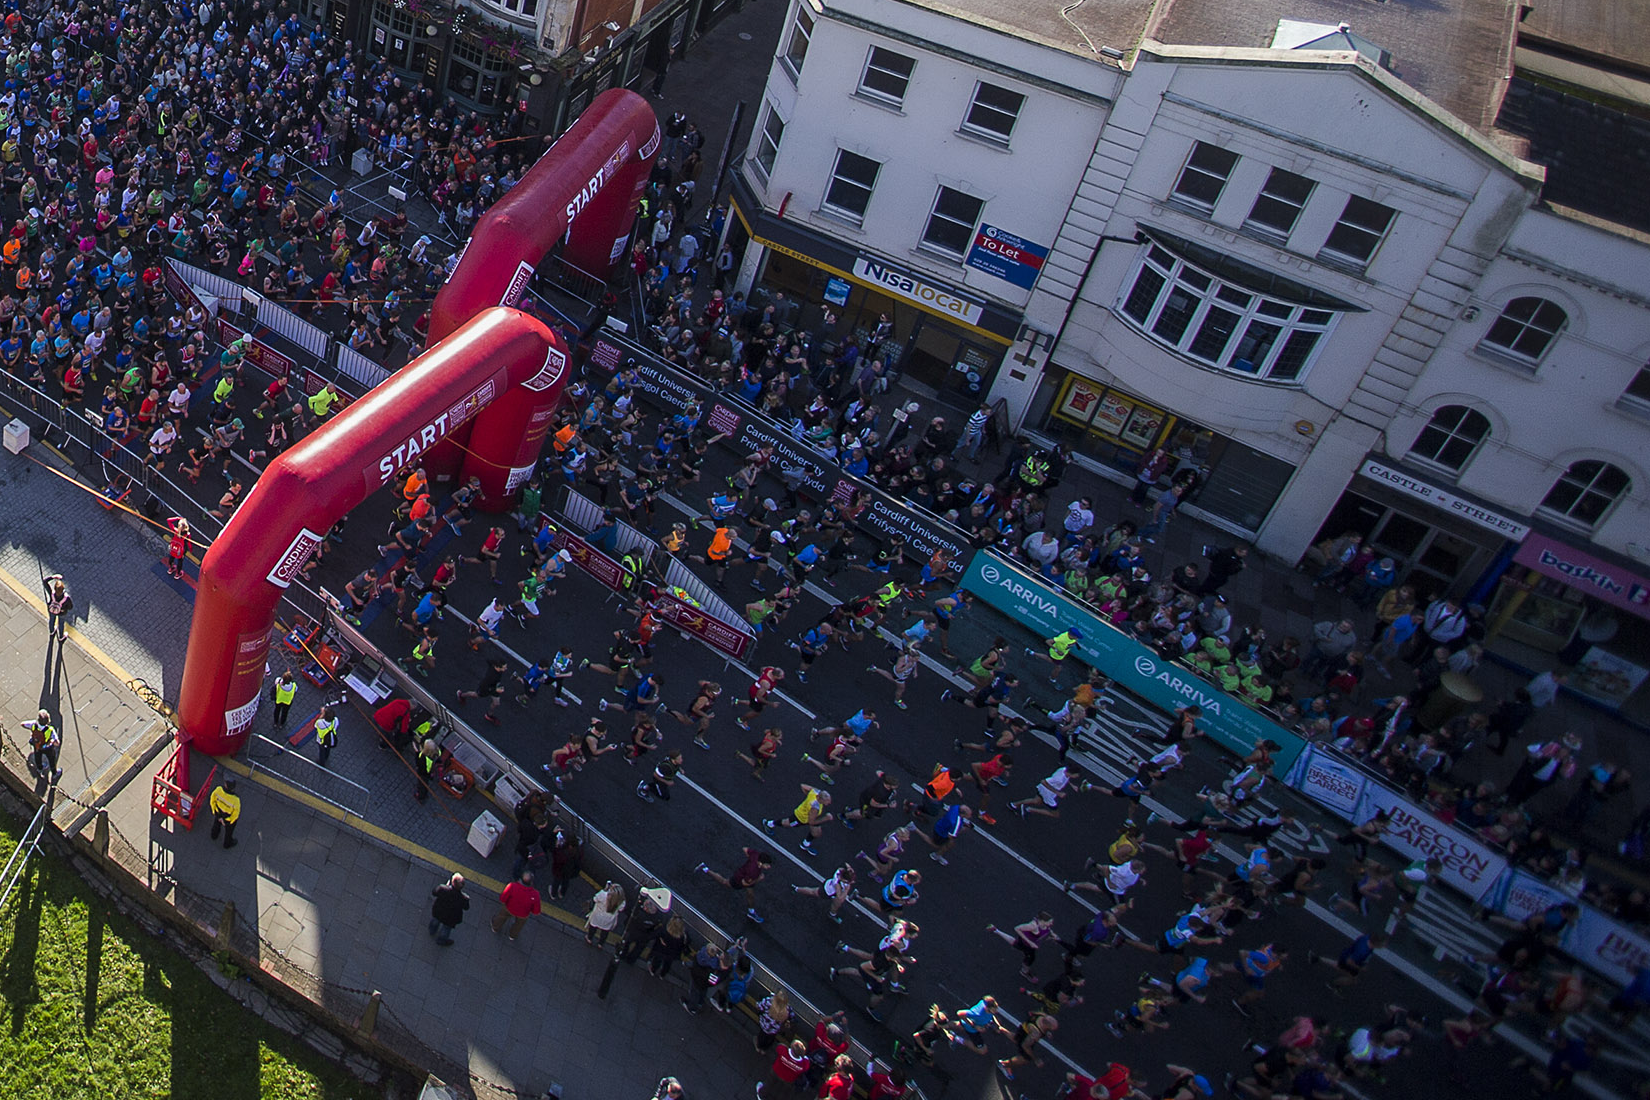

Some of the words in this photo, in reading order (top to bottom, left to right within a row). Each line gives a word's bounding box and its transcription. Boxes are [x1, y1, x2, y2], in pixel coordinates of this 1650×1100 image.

[565, 168, 604, 224] START
[762, 239, 789, 253] CASTLE
[794, 252, 819, 265] STREET
[983, 236, 997, 250] To
[998, 243, 1019, 259] Let
[504, 268, 527, 305] CARDIFF
[863, 261, 972, 316] Nisalocal
[713, 403, 740, 422] CARDIFF
[379, 413, 449, 482] START
[776, 443, 825, 477] Univerty
[1368, 465, 1431, 497] CASTLE
[1450, 500, 1521, 535] STREET
[872, 500, 910, 527] Cardiff
[909, 521, 963, 557] University
[275, 536, 308, 577] CARDIFF
[285, 542, 313, 578] UNIVERSITY
[590, 554, 616, 572] CARDIFF
[1540, 549, 1623, 595] baskin
[997, 576, 1061, 619] ARRIVA
[707, 622, 737, 640] CARDIFF
[1154, 669, 1224, 716] ARRIVA
[1306, 774, 1354, 800] CARREG
[1308, 767, 1357, 793] BRECON
[1382, 819, 1482, 884] CARREG
[1386, 805, 1489, 872] BRECON
